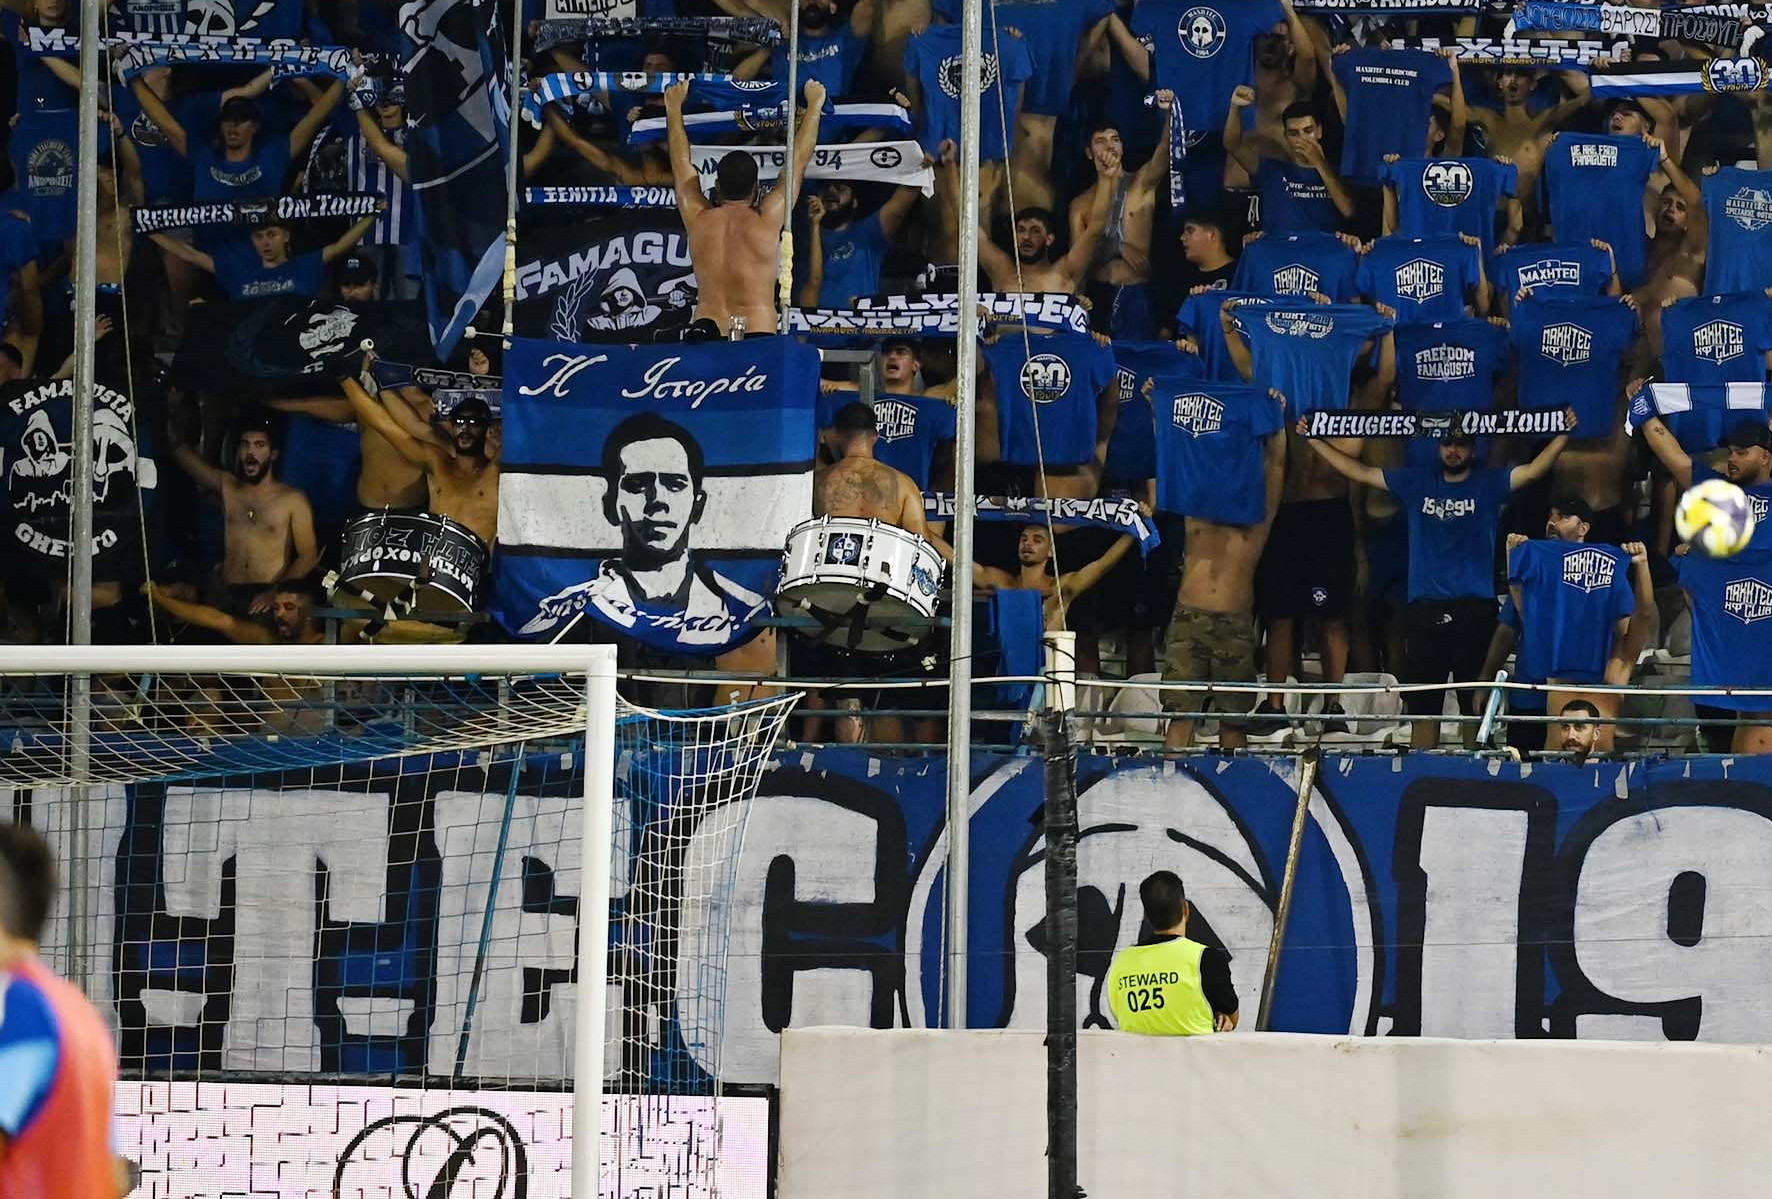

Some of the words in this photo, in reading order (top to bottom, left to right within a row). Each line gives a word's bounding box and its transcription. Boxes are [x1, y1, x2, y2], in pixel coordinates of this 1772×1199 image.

[136, 203, 235, 235] REFUGEES
[1414, 345, 1475, 365] FREEDOM
[1416, 361, 1475, 380] FAMAGUSTA
[1311, 411, 1417, 437] REFUGEES
[1117, 969, 1179, 992] STEWARD
[1127, 987, 1165, 1013] 025
